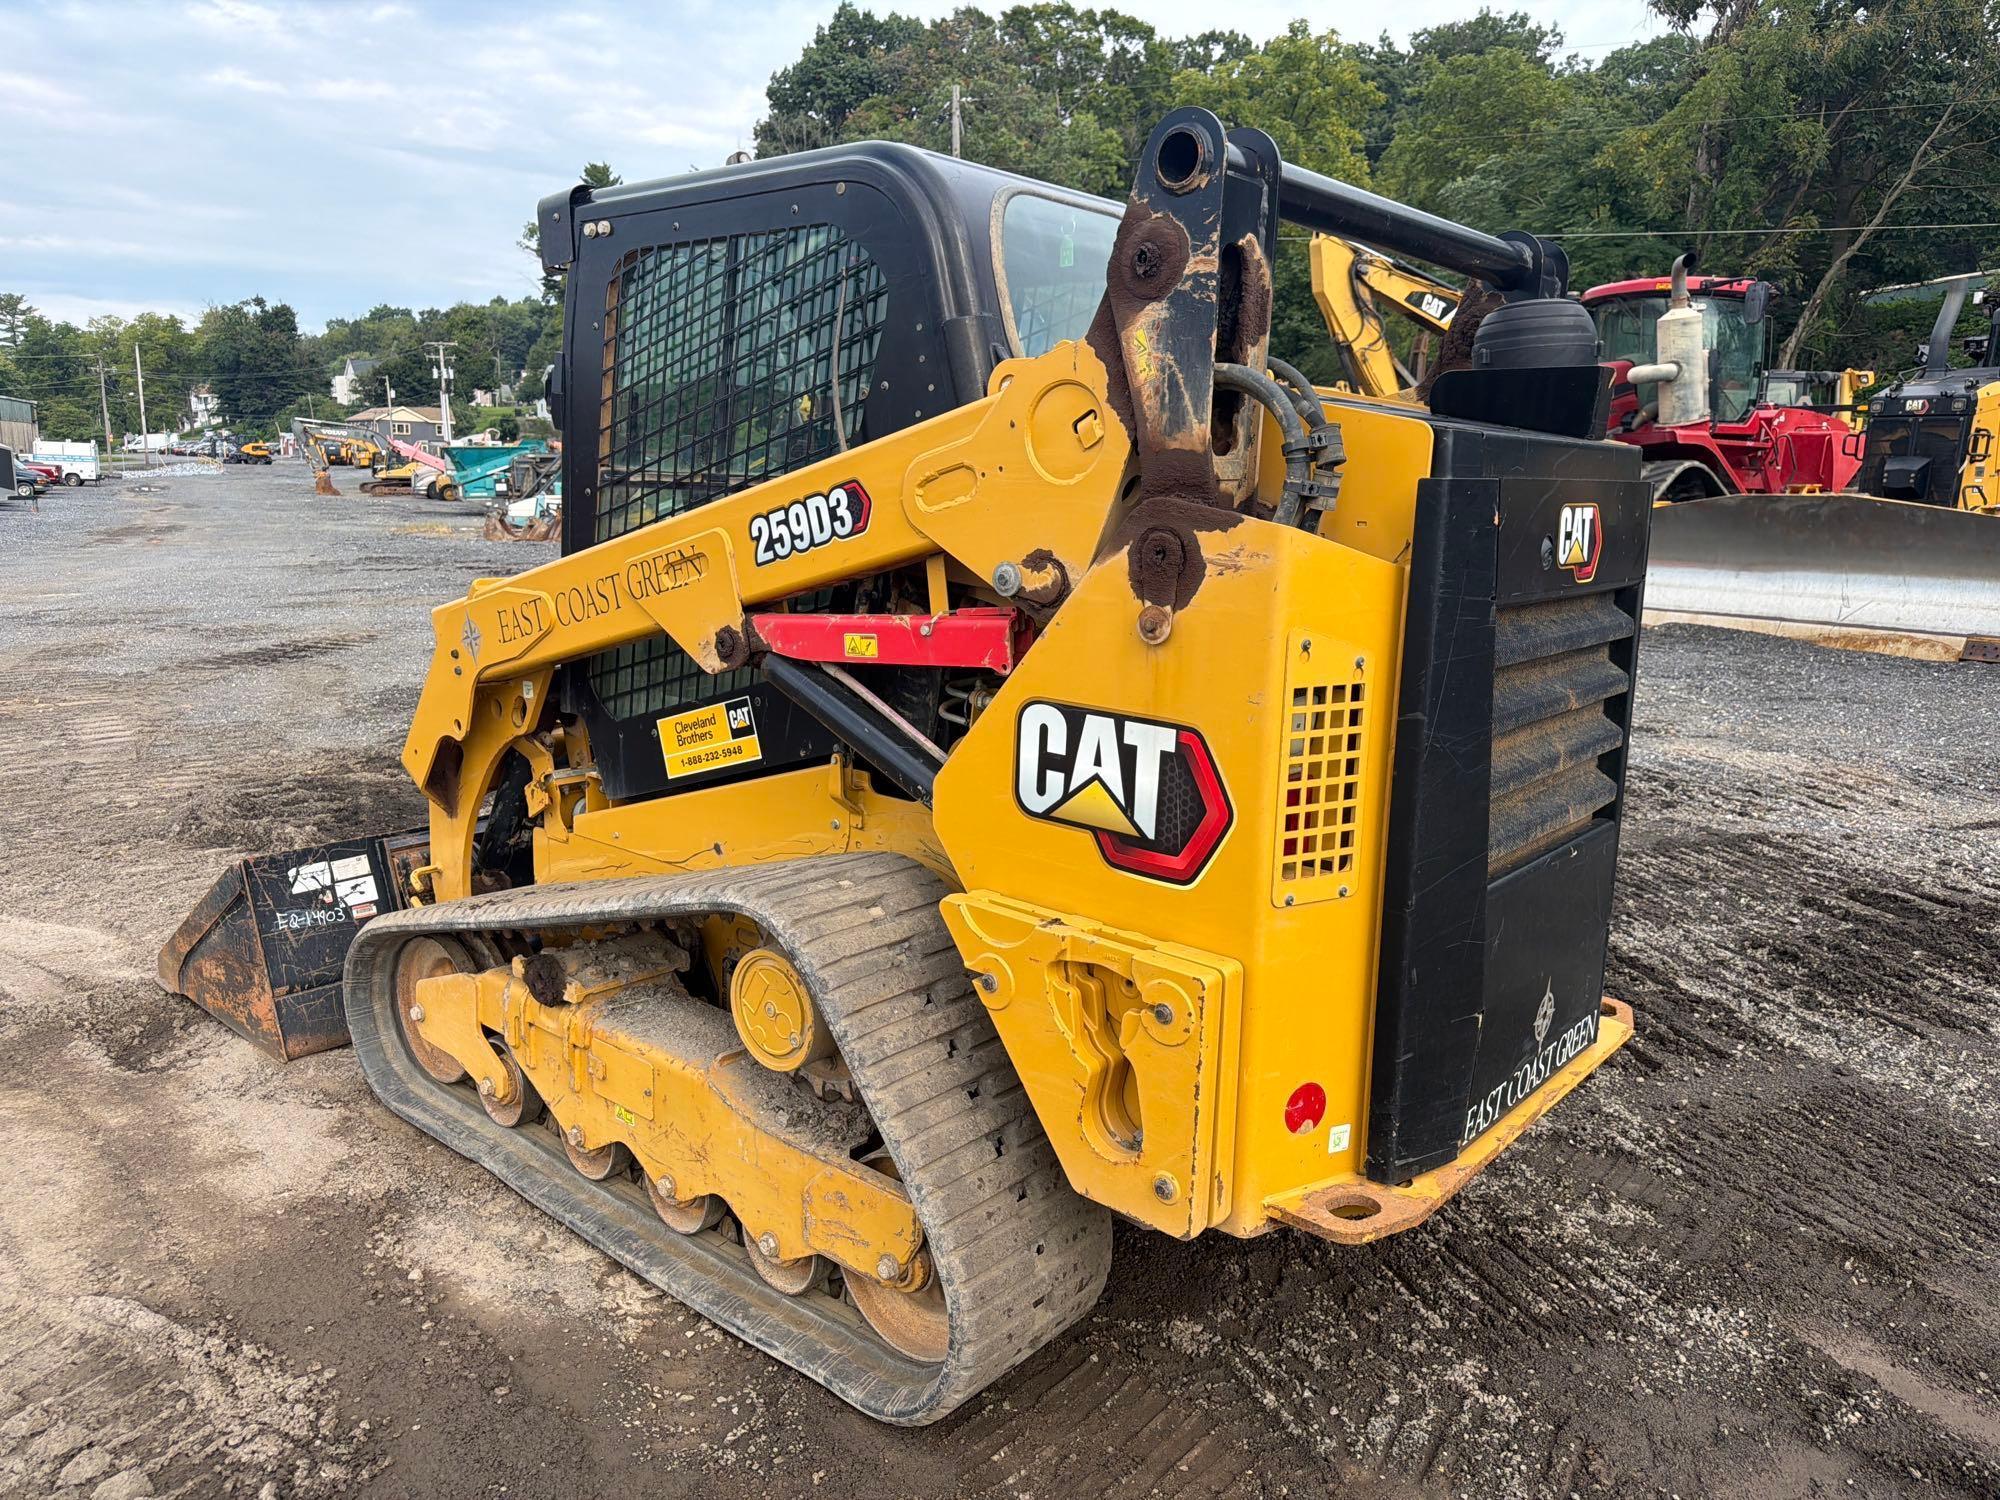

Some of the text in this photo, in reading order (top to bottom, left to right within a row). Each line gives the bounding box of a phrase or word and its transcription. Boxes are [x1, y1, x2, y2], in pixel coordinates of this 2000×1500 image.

[1421, 293, 1447, 319] CAT
[1905, 399, 1923, 411] CAT
[751, 487, 853, 564] 259D3
[1558, 506, 1594, 565] CAT
[497, 545, 704, 644] EAST COAST GREEN
[674, 713, 717, 735] Cleveland
[728, 706, 751, 730] CAT
[676, 730, 714, 747] Brothers
[680, 745, 743, 767] 1-888-232-5948
[1018, 703, 1177, 841] CAT
[1462, 1010, 1598, 1146] EAST COAST GREEN
